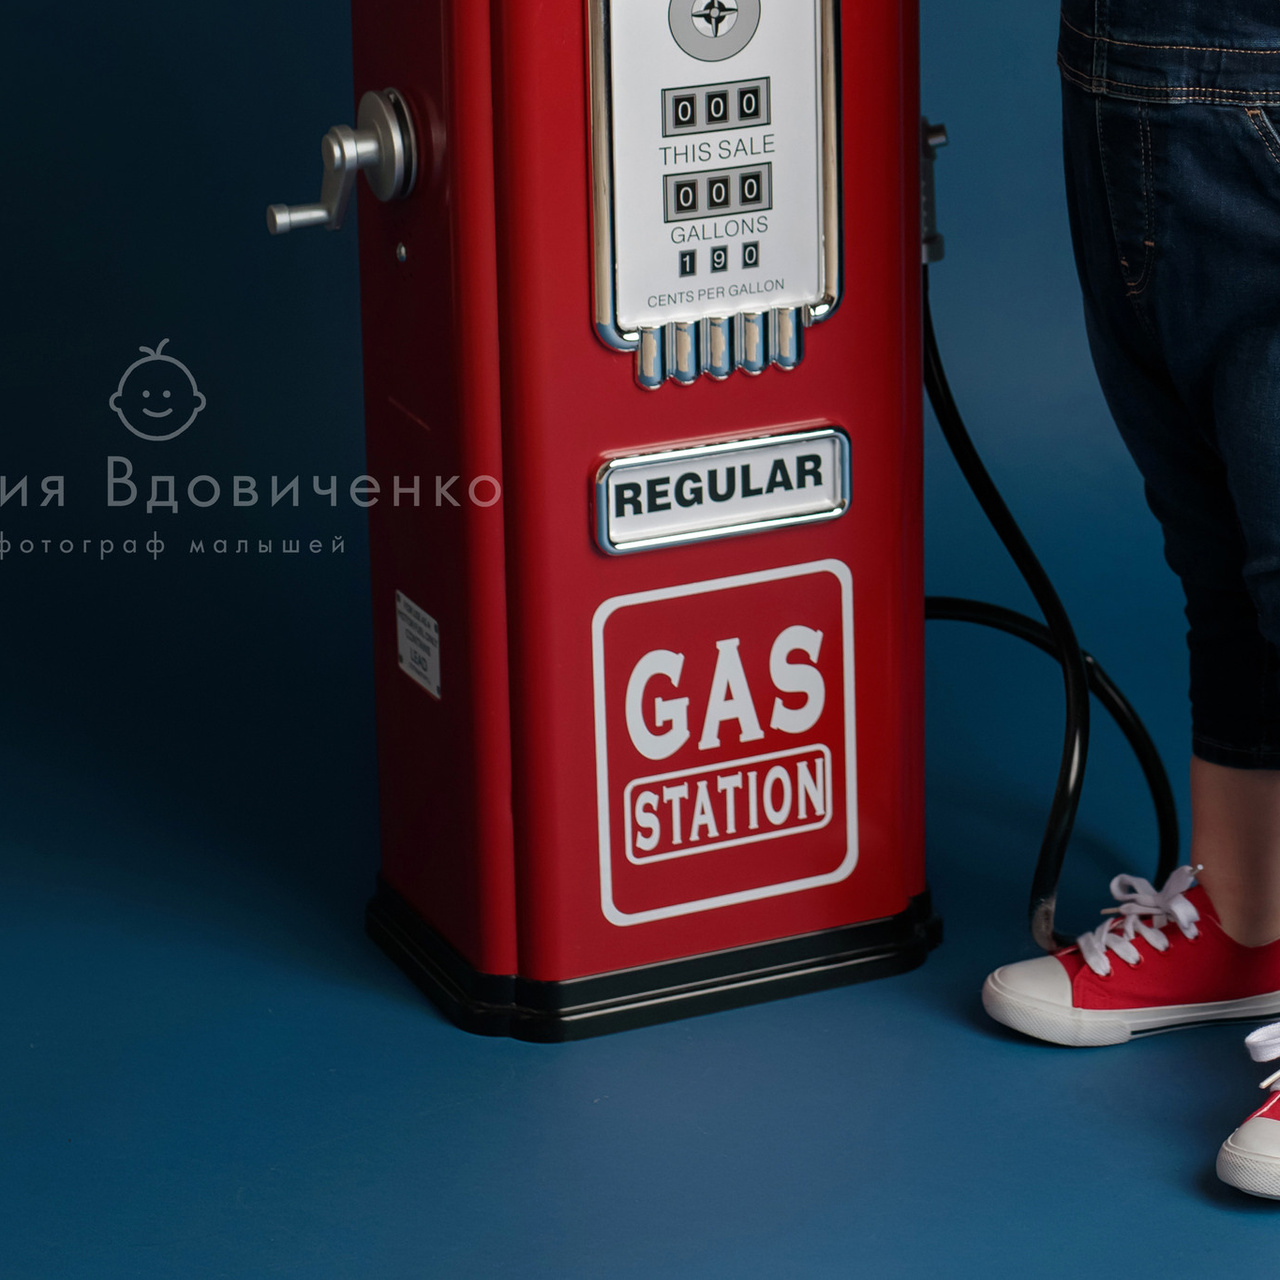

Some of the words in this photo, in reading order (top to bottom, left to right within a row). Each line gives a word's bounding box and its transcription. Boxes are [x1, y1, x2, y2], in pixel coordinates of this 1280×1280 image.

[659, 142, 712, 166] THIS
[718, 133, 775, 160] SALE
[671, 215, 769, 244] GALLONS
[647, 290, 695, 308] CENTS
[698, 286, 725, 301] PER
[728, 278, 785, 297] GALLON
[613, 453, 824, 518] REGULAR
[625, 625, 826, 761] GAS
[635, 757, 826, 852] STATION
